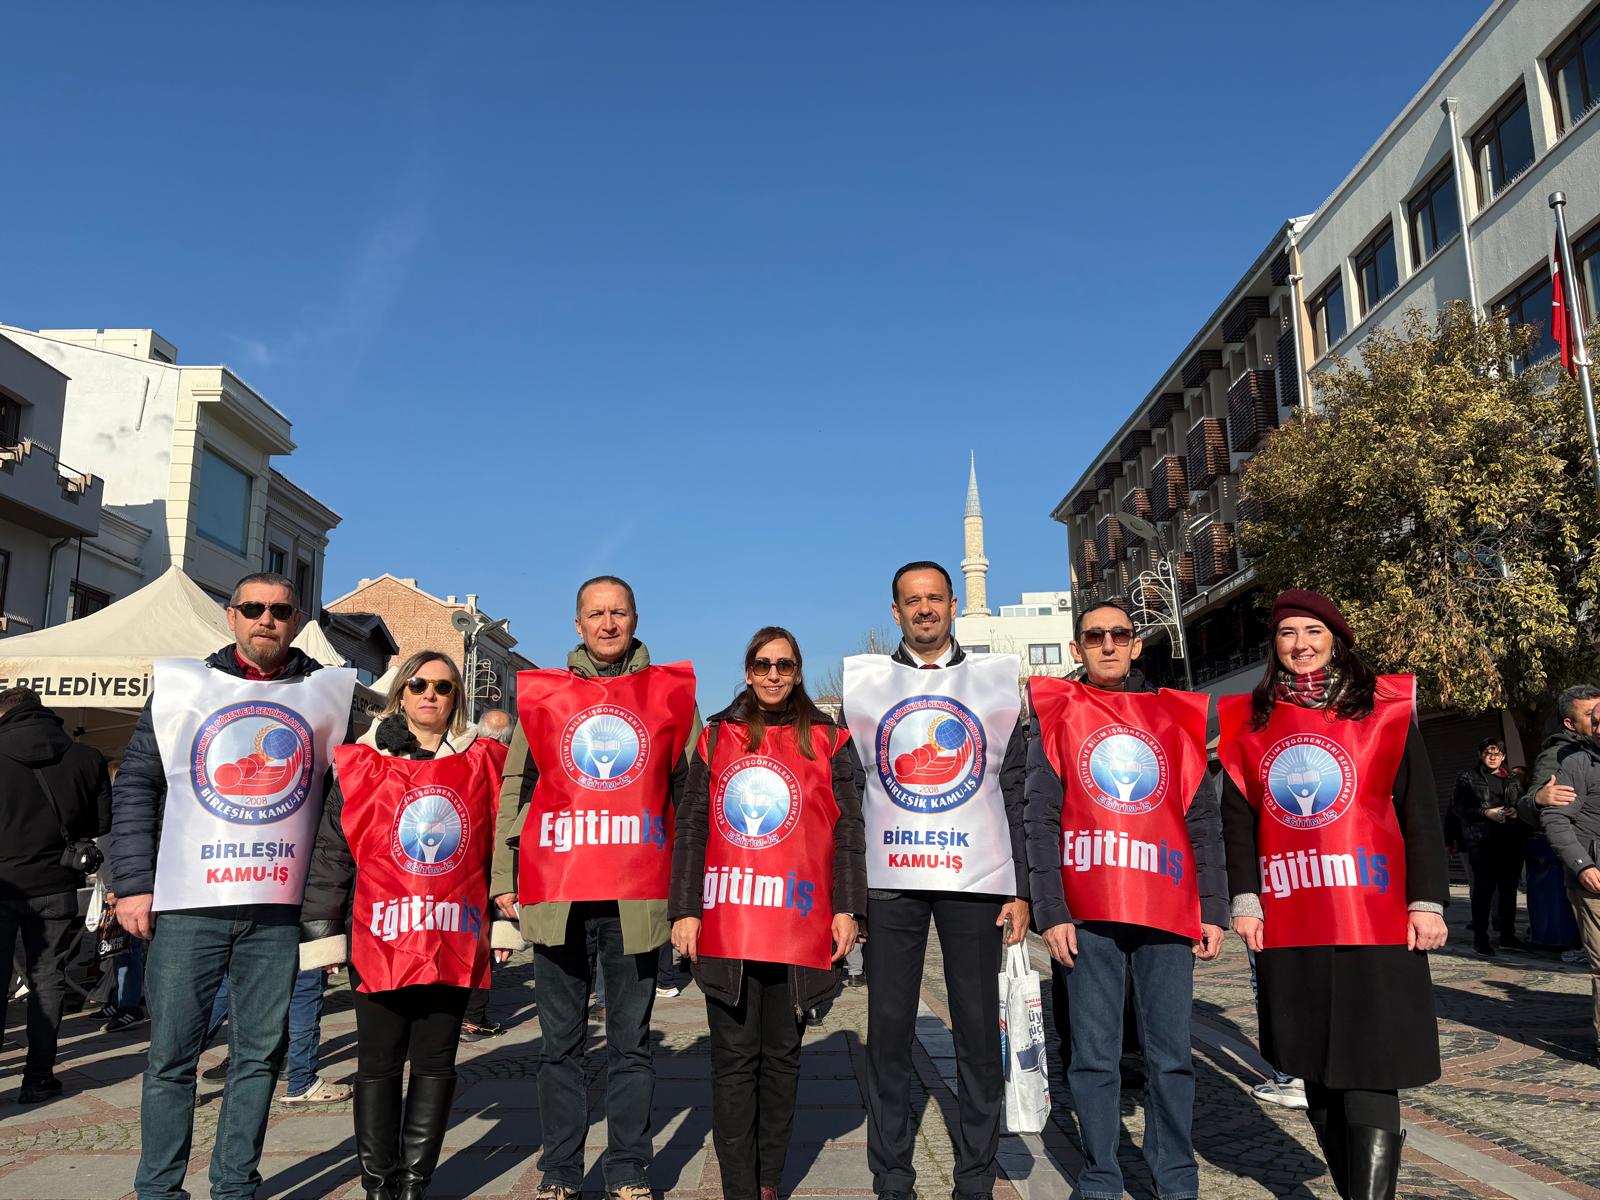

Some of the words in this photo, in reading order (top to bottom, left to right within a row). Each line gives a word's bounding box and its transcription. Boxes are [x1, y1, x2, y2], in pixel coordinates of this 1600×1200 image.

[16, 672, 149, 697] BELEDİYESİ
[564, 733, 572, 744] VE
[1082, 749, 1091, 759] VE
[245, 796, 268, 806] 2008
[885, 777, 927, 809] BİRLEŞİK
[930, 778, 977, 808] KAMU-İŞ
[919, 785, 939, 794] 2008
[201, 787, 255, 820] BİRLEŞİK
[258, 788, 305, 819] KAMU-İŞ
[200, 838, 296, 862] BİRLEŞİK
[883, 825, 970, 851] BİRLEŞİK
[206, 862, 289, 886] KAMU-İŞ
[888, 851, 963, 874] KAMU-İŞ
